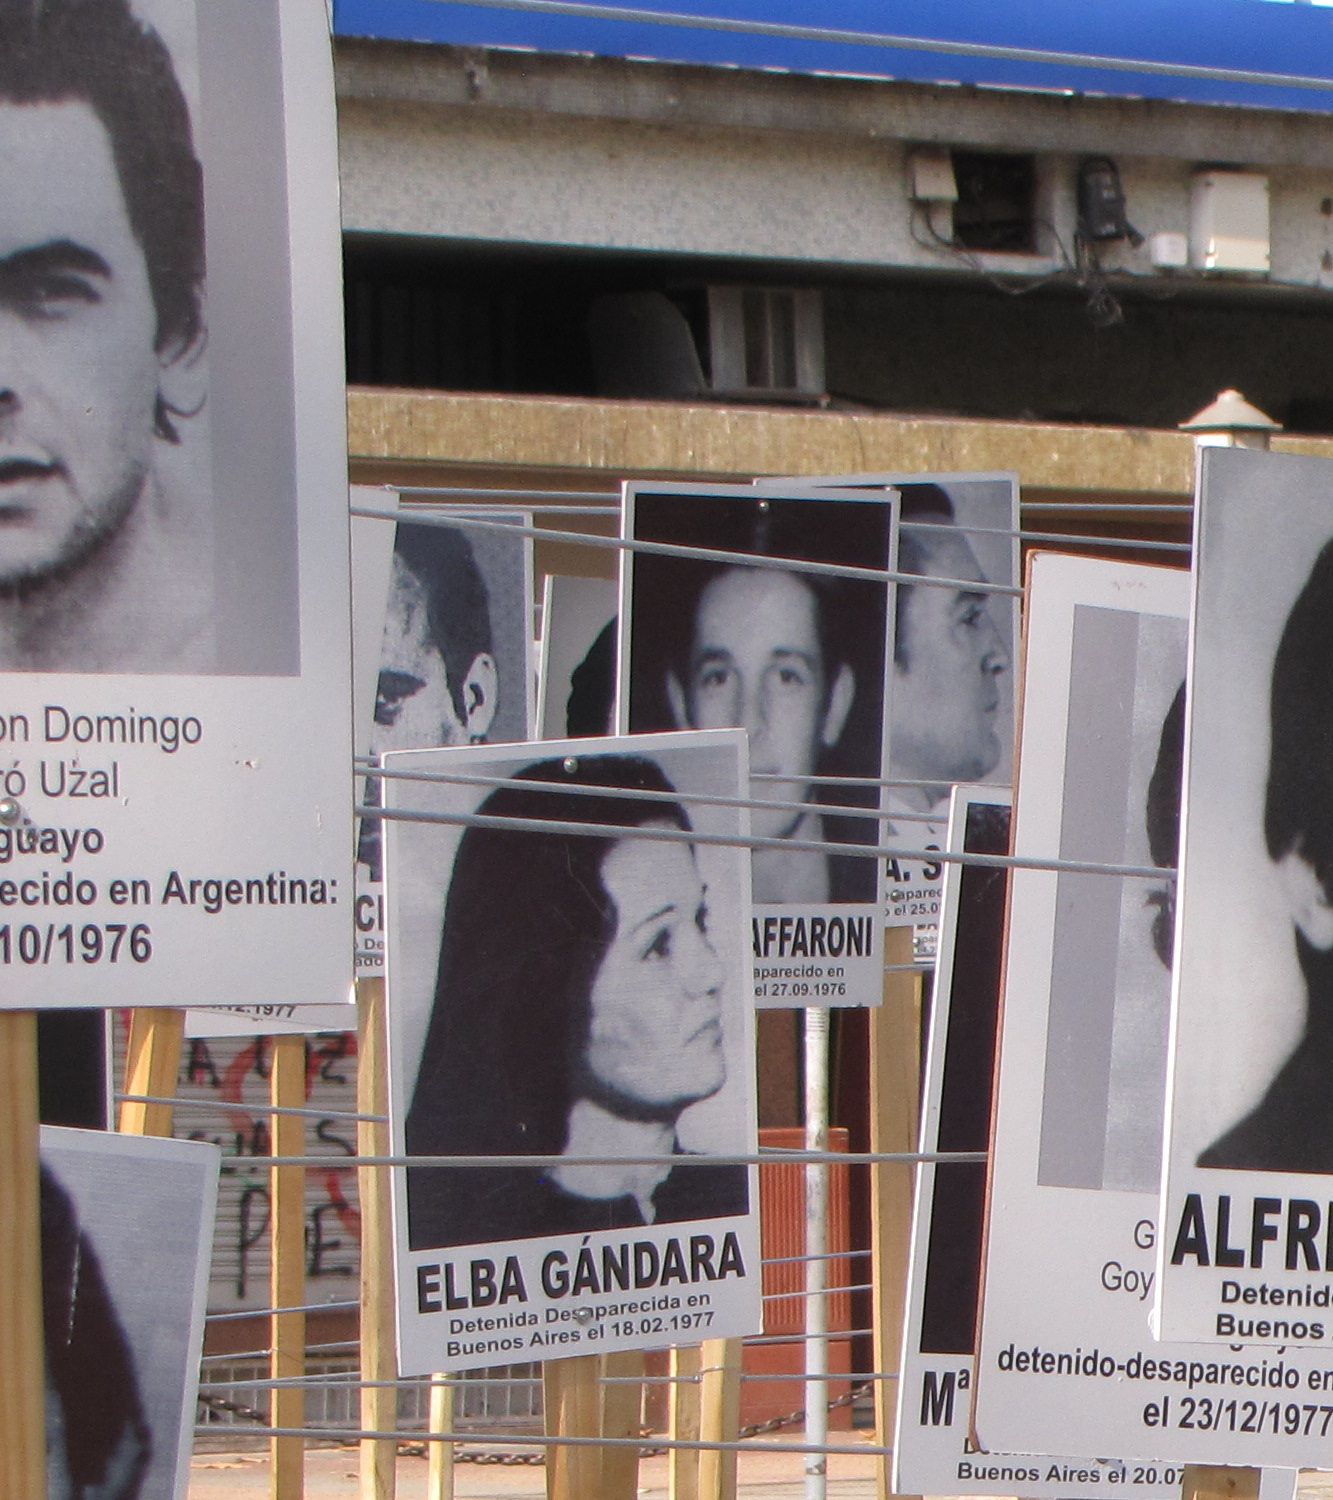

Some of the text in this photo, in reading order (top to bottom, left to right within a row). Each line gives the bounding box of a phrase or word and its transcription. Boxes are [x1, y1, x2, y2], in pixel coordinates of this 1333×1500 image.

[44, 706, 201, 753] Domingo
[41, 760, 119, 798] Uzal
[0, 827, 105, 863] guayo
[110, 880, 151, 905] en
[161, 871, 338, 914] Argentina:
[0, 923, 153, 964] 10/1976
[752, 917, 873, 958] AFFARONI
[754, 965, 844, 981] aparecido en
[771, 983, 846, 996] 27.09.1976
[417, 1231, 747, 1314] ELBA GÁNDARA
[447, 1311, 715, 1357] Buenos Aires el 18.02.1977
[450, 1310, 539, 1335] Detenida
[687, 1293, 711, 1308] en
[1215, 1313, 1324, 1342] Buenos
[998, 1343, 1300, 1389] detenido-desaparecido
[1143, 1396, 1168, 1427] el
[957, 1462, 1184, 1486] Buenos Aires el 20.07
